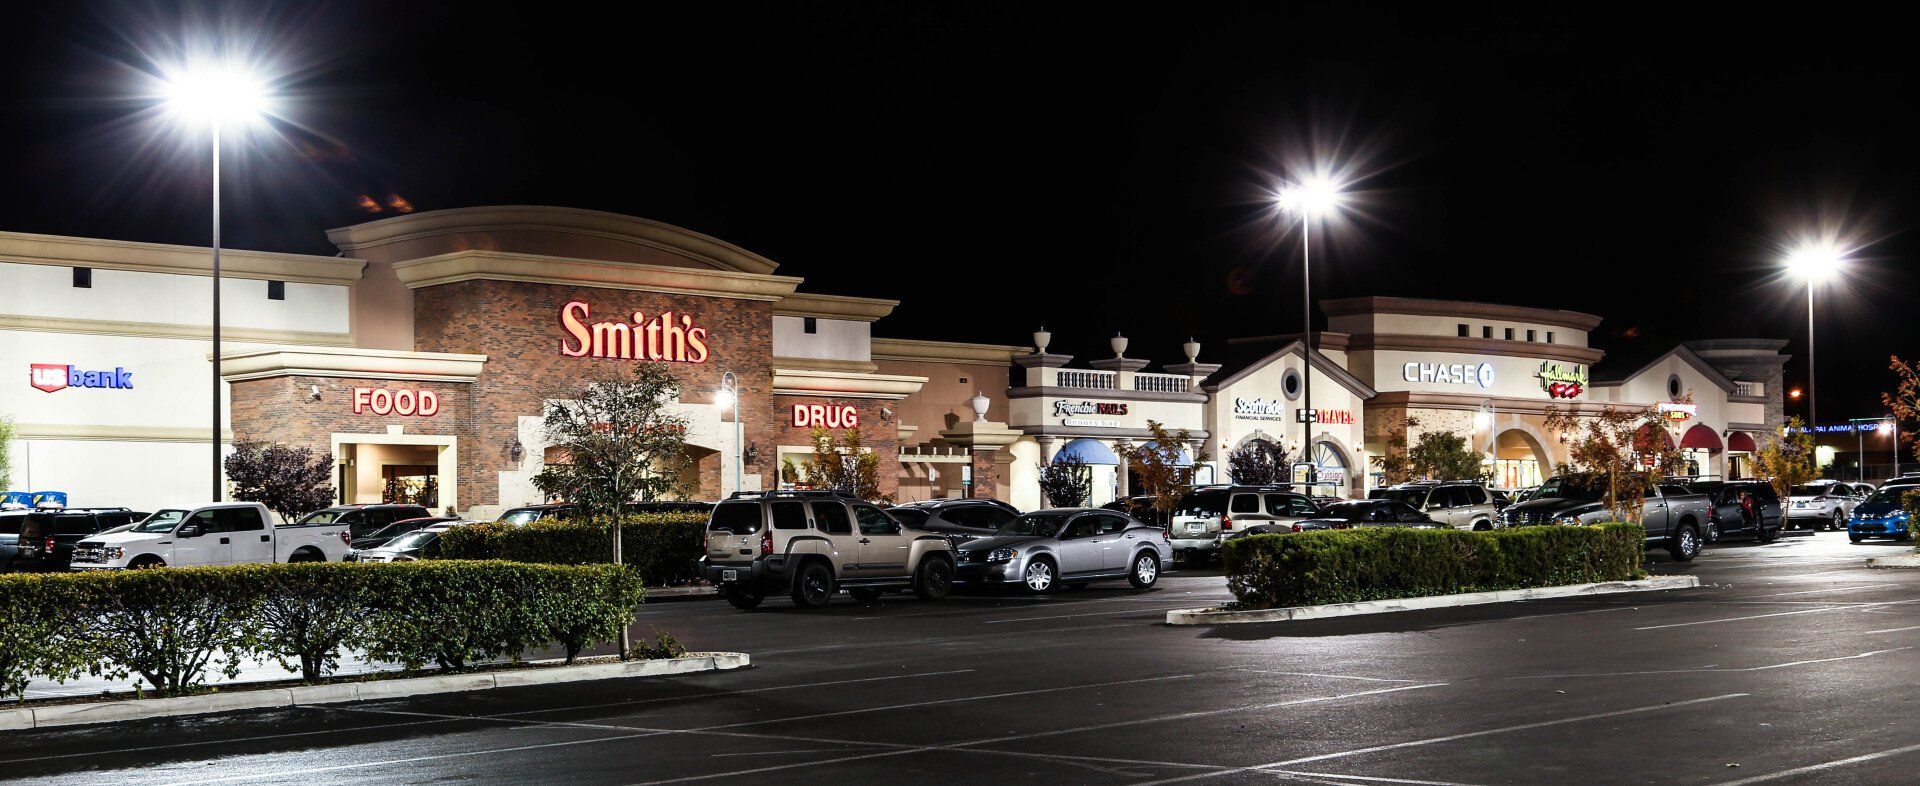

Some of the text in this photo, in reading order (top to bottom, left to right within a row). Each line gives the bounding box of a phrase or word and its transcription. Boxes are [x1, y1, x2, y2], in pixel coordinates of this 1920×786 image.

[560, 301, 710, 363] Smith's
[1403, 362, 1476, 384] CHASE
[1538, 361, 1588, 387] Hallmark
[353, 388, 439, 416] FOOD
[792, 404, 859, 428] DRUG
